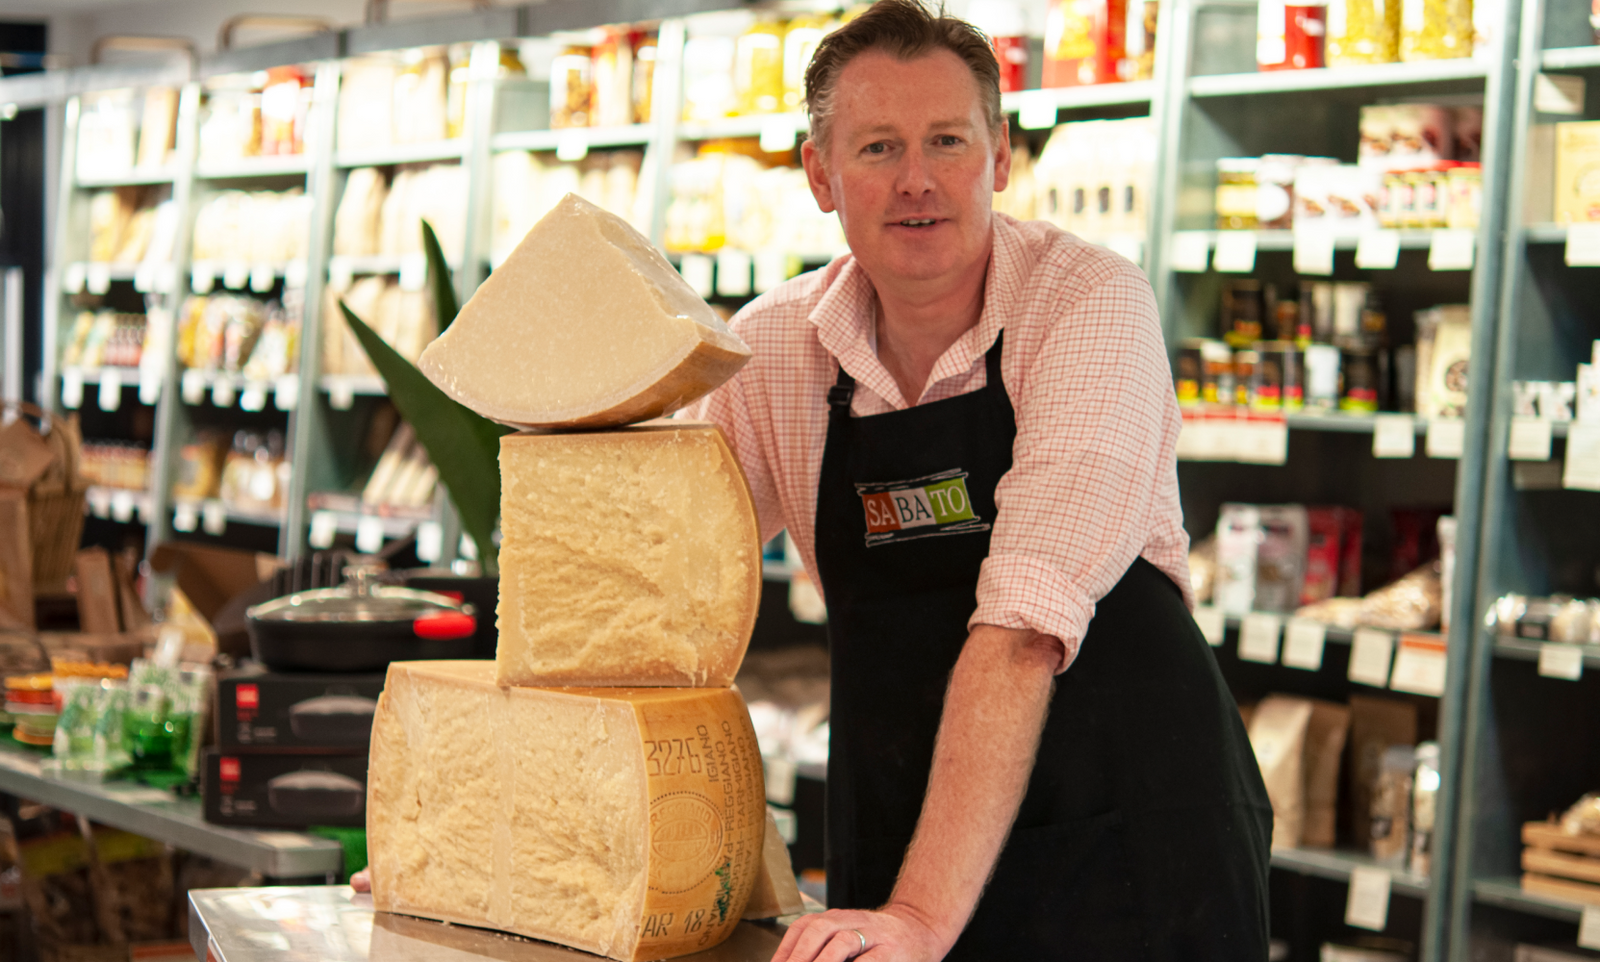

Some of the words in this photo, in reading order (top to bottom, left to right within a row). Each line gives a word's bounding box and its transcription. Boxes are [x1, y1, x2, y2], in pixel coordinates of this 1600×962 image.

[867, 486, 966, 526] SABATO
[644, 737, 702, 777] 3276
[696, 724, 719, 782] IGIANO
[721, 721, 746, 829] PARMIGIANO
[715, 741, 734, 832] REGGIANO
[641, 912, 675, 938] AR
[684, 908, 706, 935] 18
